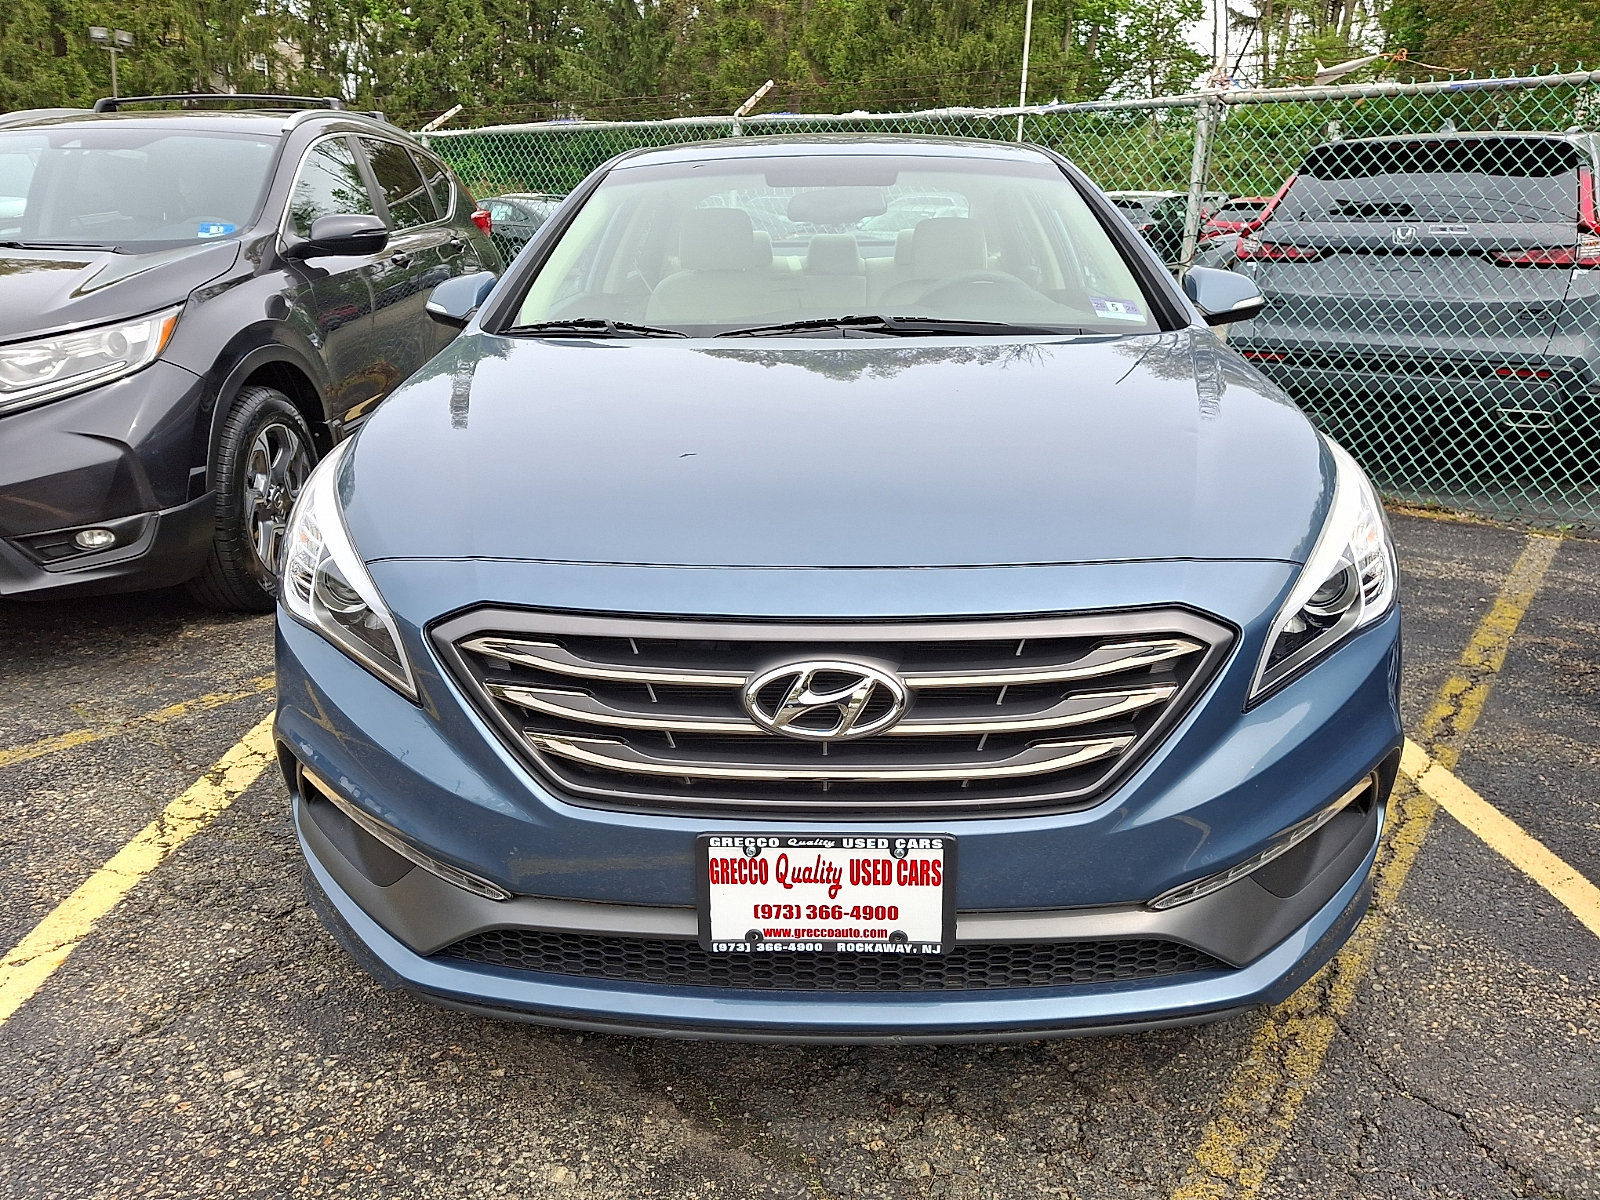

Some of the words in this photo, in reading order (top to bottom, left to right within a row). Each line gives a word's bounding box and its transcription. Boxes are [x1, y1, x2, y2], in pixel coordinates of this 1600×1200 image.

[1111, 303, 1119, 311] 5
[709, 837, 780, 847] GRECCO
[787, 838, 836, 848] Quality
[842, 838, 890, 849] USED
[895, 838, 944, 849] CARS
[710, 857, 769, 885] GRECCO
[775, 853, 842, 899] Quality
[849, 858, 892, 886] USED
[896, 858, 942, 887] CARS
[753, 904, 802, 920] (973)
[805, 905, 899, 920] 366-4900
[762, 927, 888, 939] www.greccoauto.com
[756, 943, 823, 952] 366-4900
[836, 943, 917, 954] ROCKAWAY,
[921, 944, 941, 954] NJ
